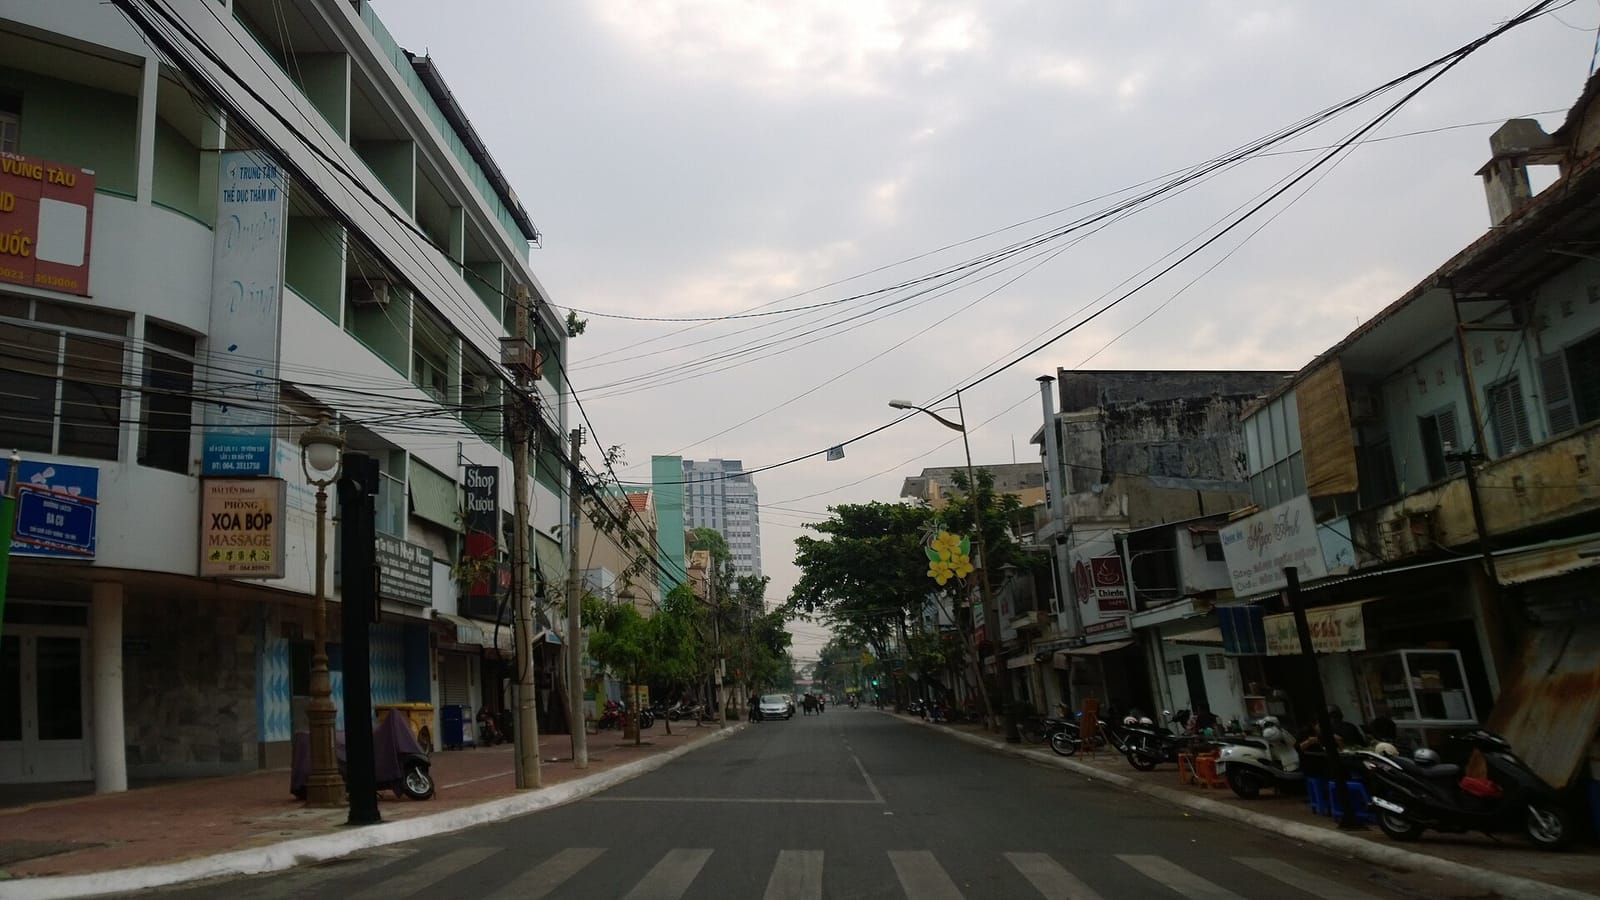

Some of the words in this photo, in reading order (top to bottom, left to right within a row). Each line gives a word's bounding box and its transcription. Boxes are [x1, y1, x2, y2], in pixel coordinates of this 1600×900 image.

[47, 166, 77, 188] TÀU
[240, 167, 260, 180] TRUNG
[467, 468, 495, 495] Shop
[225, 498, 258, 510] PHÒNG
[467, 492, 495, 514] Rượu
[211, 513, 242, 531] XOA
[245, 508, 272, 531] BÓP
[208, 534, 273, 547] MASSAGE
